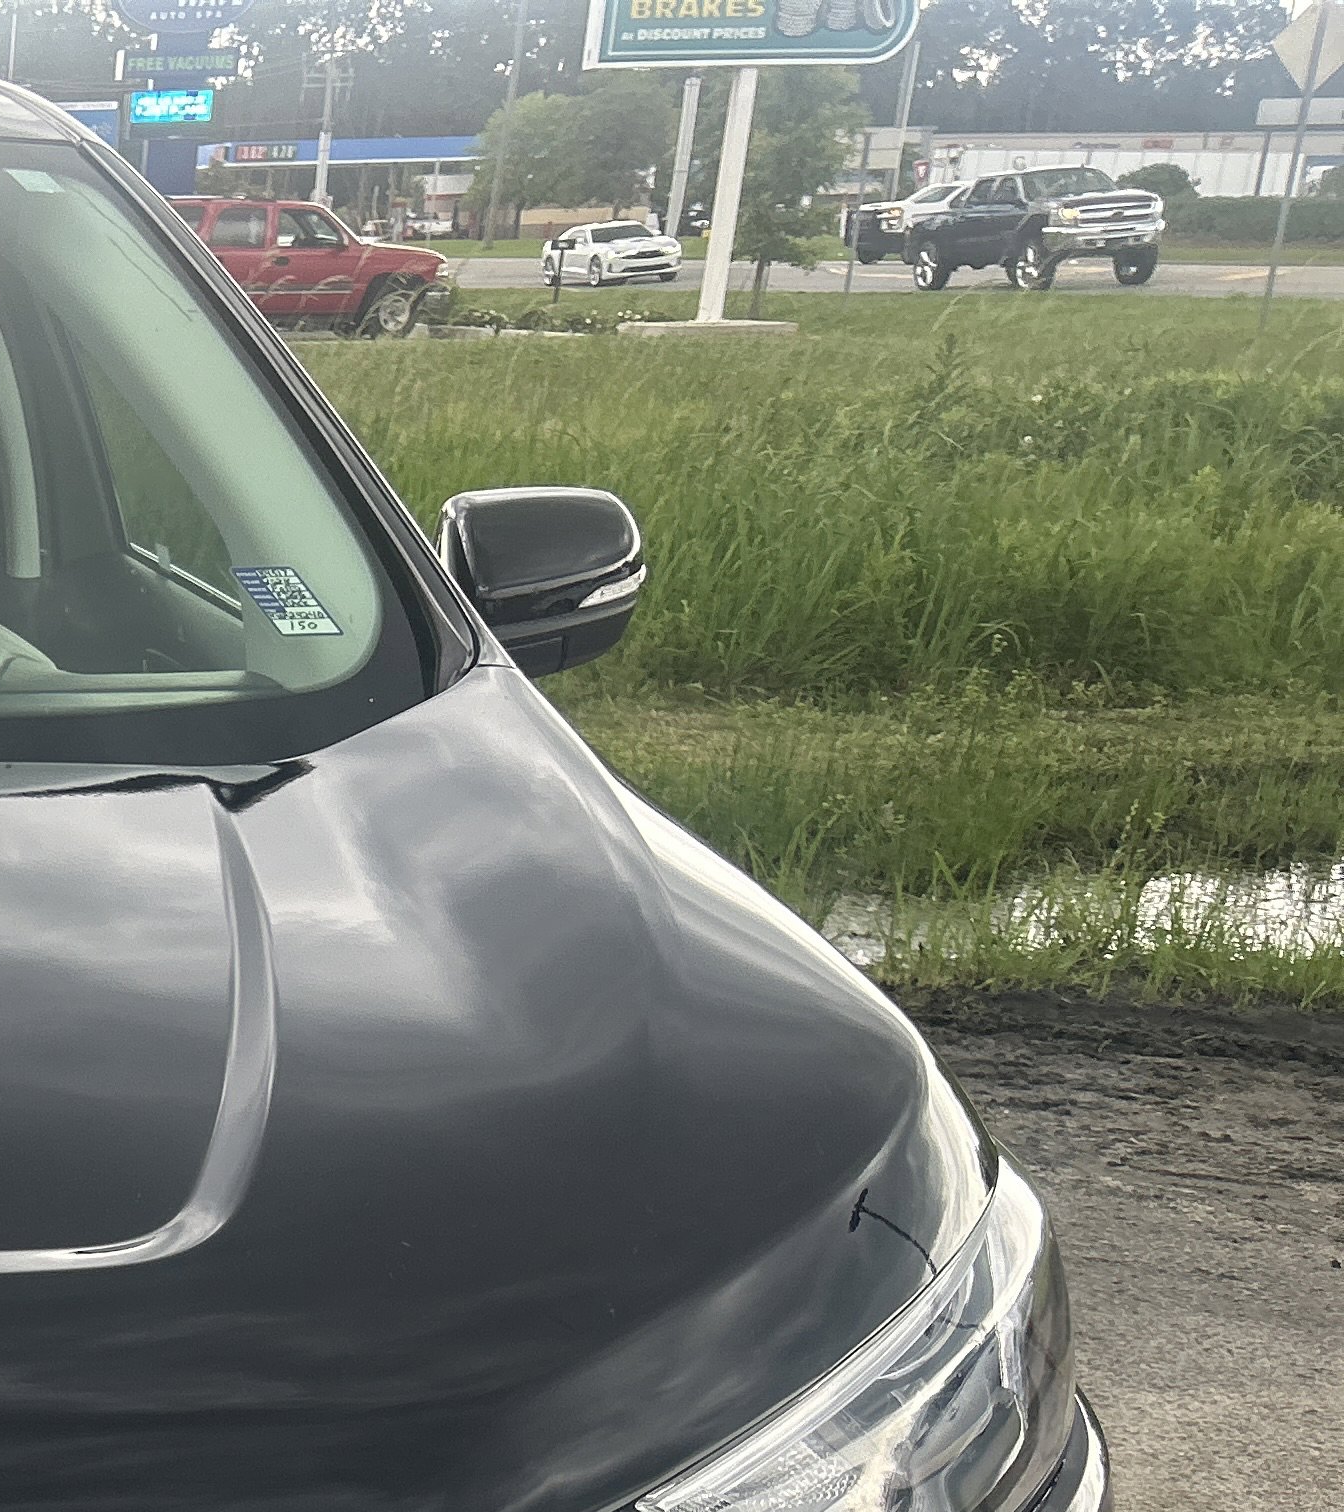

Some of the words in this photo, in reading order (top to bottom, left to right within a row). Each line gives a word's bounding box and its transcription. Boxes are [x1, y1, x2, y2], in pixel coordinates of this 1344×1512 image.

[150, 11, 185, 20] AUTO
[631, 0, 766, 19] BRAKES
[637, 28, 711, 40] DISCOUNT
[713, 27, 767, 39] PRICES
[128, 57, 163, 71] FREE
[168, 55, 234, 70] VACUUMS
[290, 620, 318, 630] 150
